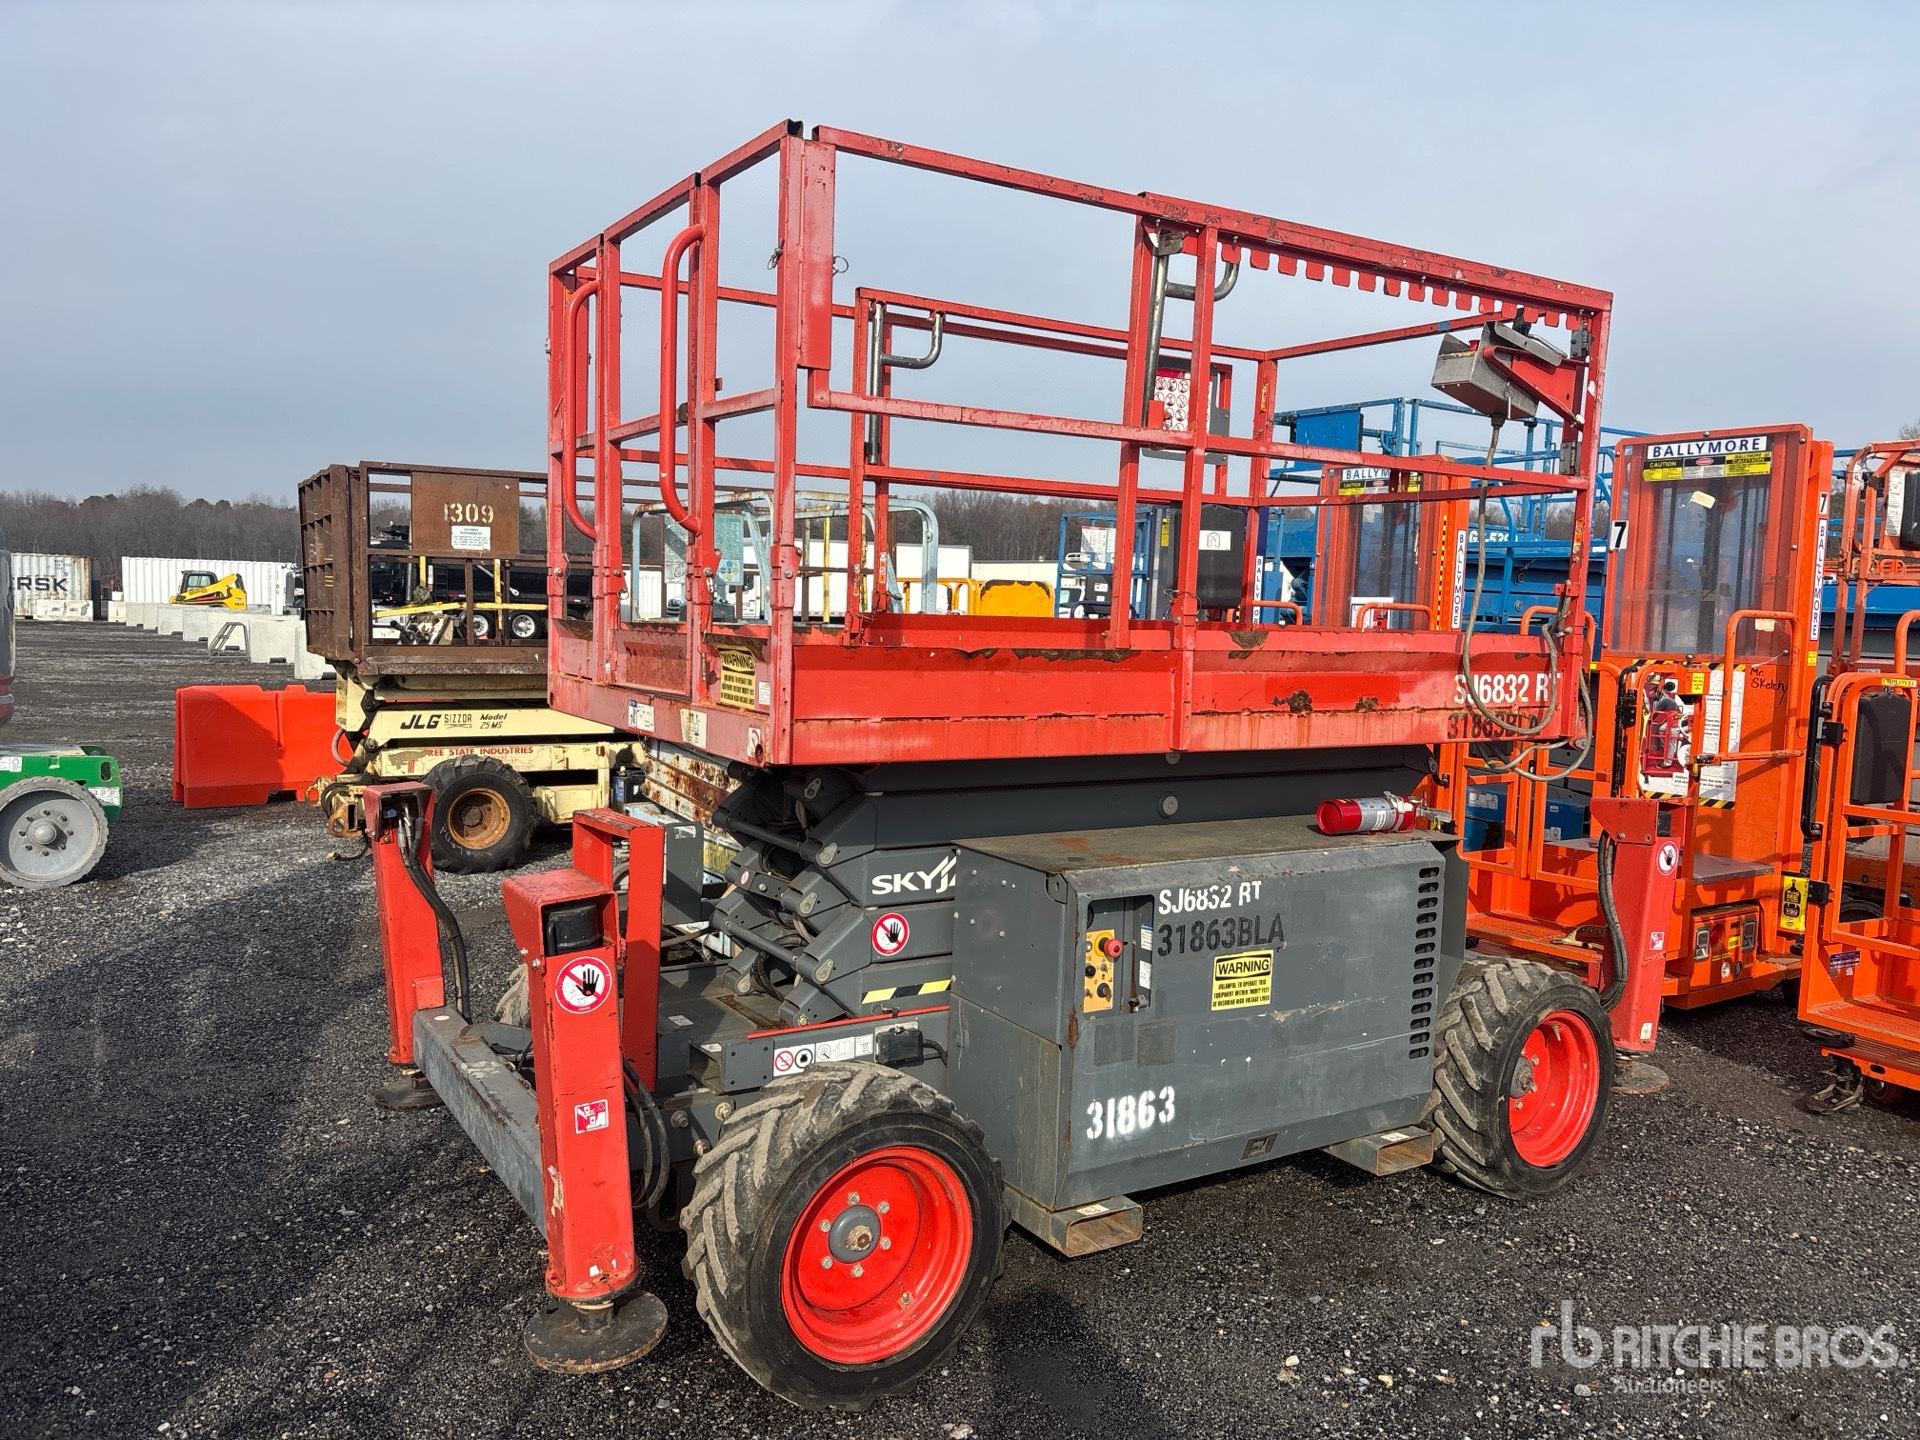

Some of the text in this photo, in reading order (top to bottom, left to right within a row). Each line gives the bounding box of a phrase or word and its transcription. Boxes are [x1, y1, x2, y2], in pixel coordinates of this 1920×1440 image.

[1652, 438, 1761, 458] BALLYMORE
[443, 503, 495, 524] 1309
[1819, 493, 1828, 513] 7
[1614, 521, 1627, 549] 7
[13, 576, 69, 592] RSK
[1453, 533, 1465, 626] BALLYMORE
[1812, 525, 1826, 637] BALLYMORE
[723, 653, 754, 669] WARNING
[1750, 667, 1765, 677] Mr.
[1453, 672, 1530, 704] SJ6832
[400, 713, 508, 730] JLG SIZZOR Model
[449, 747, 476, 756] STATE
[480, 746, 534, 755] INDUSTRIES
[871, 855, 957, 895] SKYJ
[1238, 880, 1263, 906] RT
[1157, 912, 1285, 957] 31863BLA
[1218, 959, 1269, 975] WARNING
[1085, 1085, 1176, 1140] 31863
